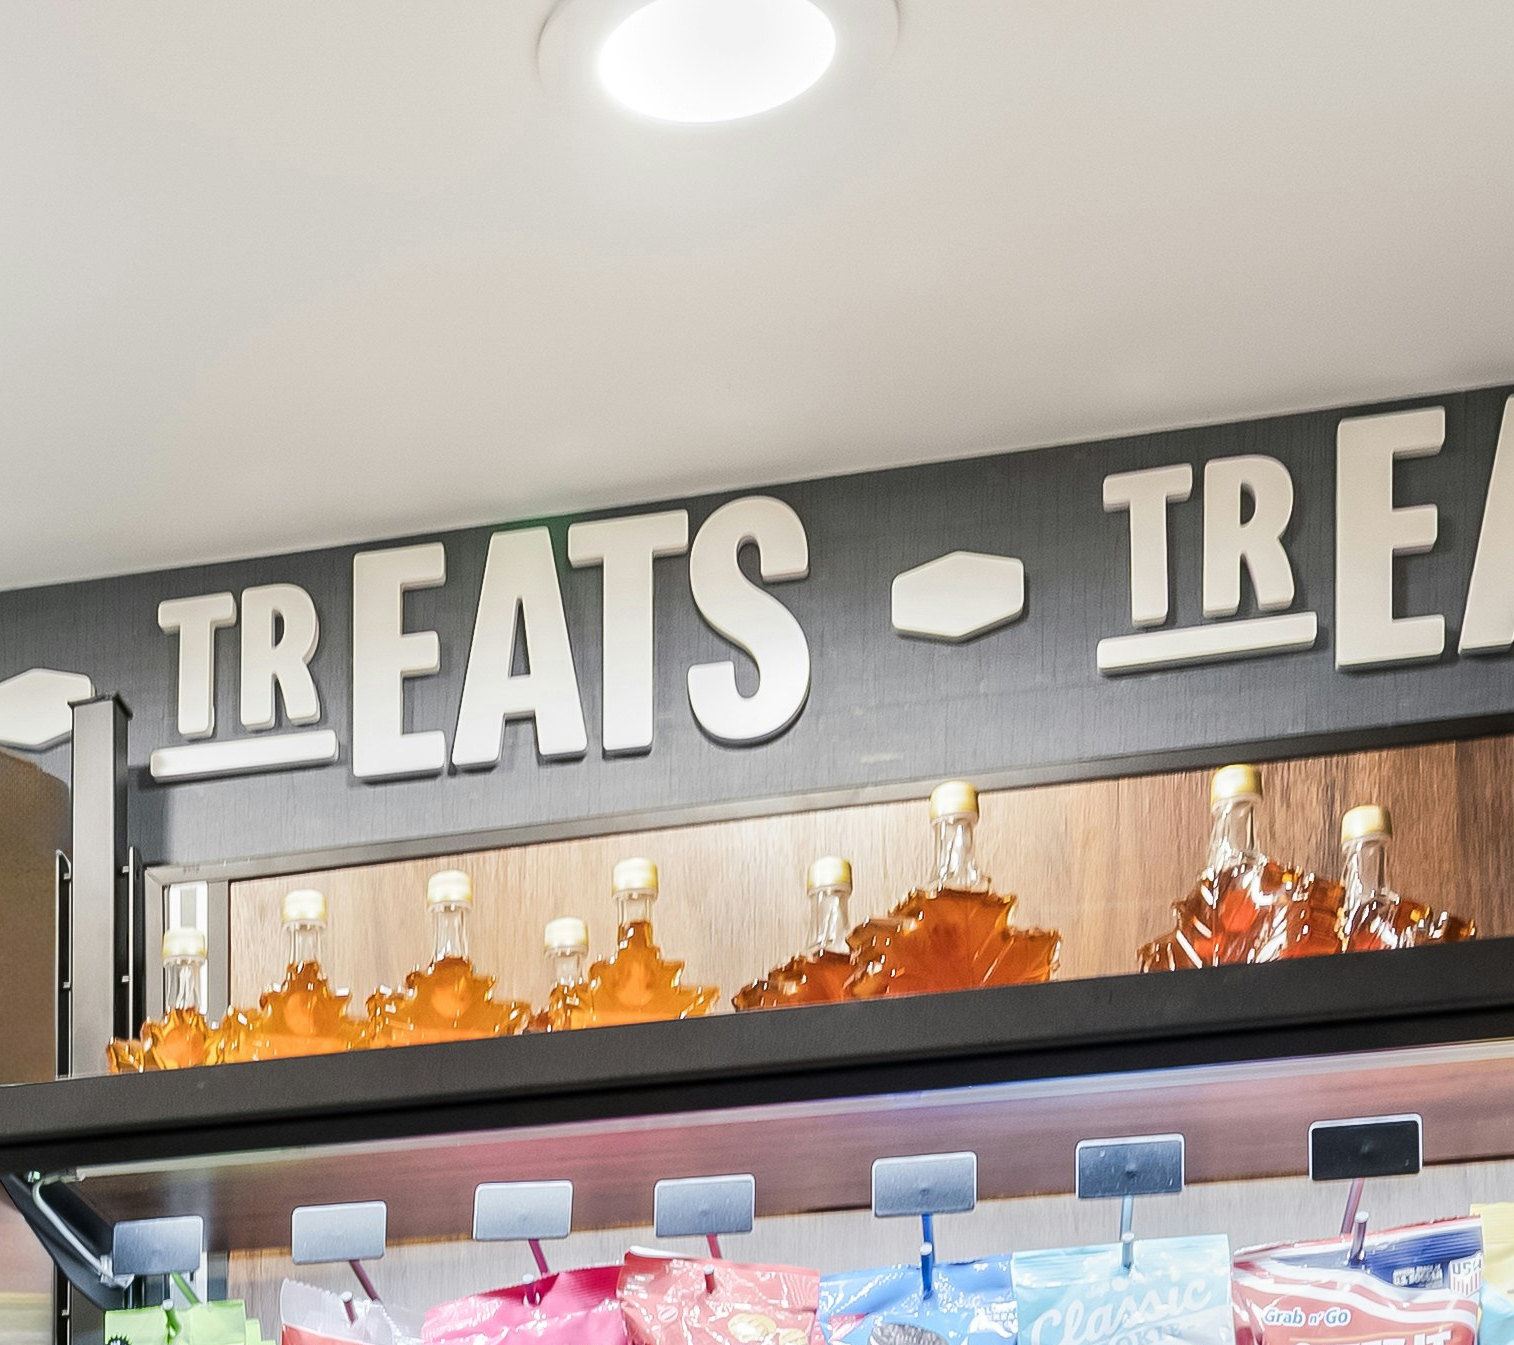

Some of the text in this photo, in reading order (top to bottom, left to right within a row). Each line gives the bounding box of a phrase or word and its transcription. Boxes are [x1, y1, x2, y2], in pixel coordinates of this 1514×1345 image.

[151, 495, 814, 783] TREATS
[1265, 1307, 1303, 1327] Grab
[1324, 1307, 1349, 1326] Go
